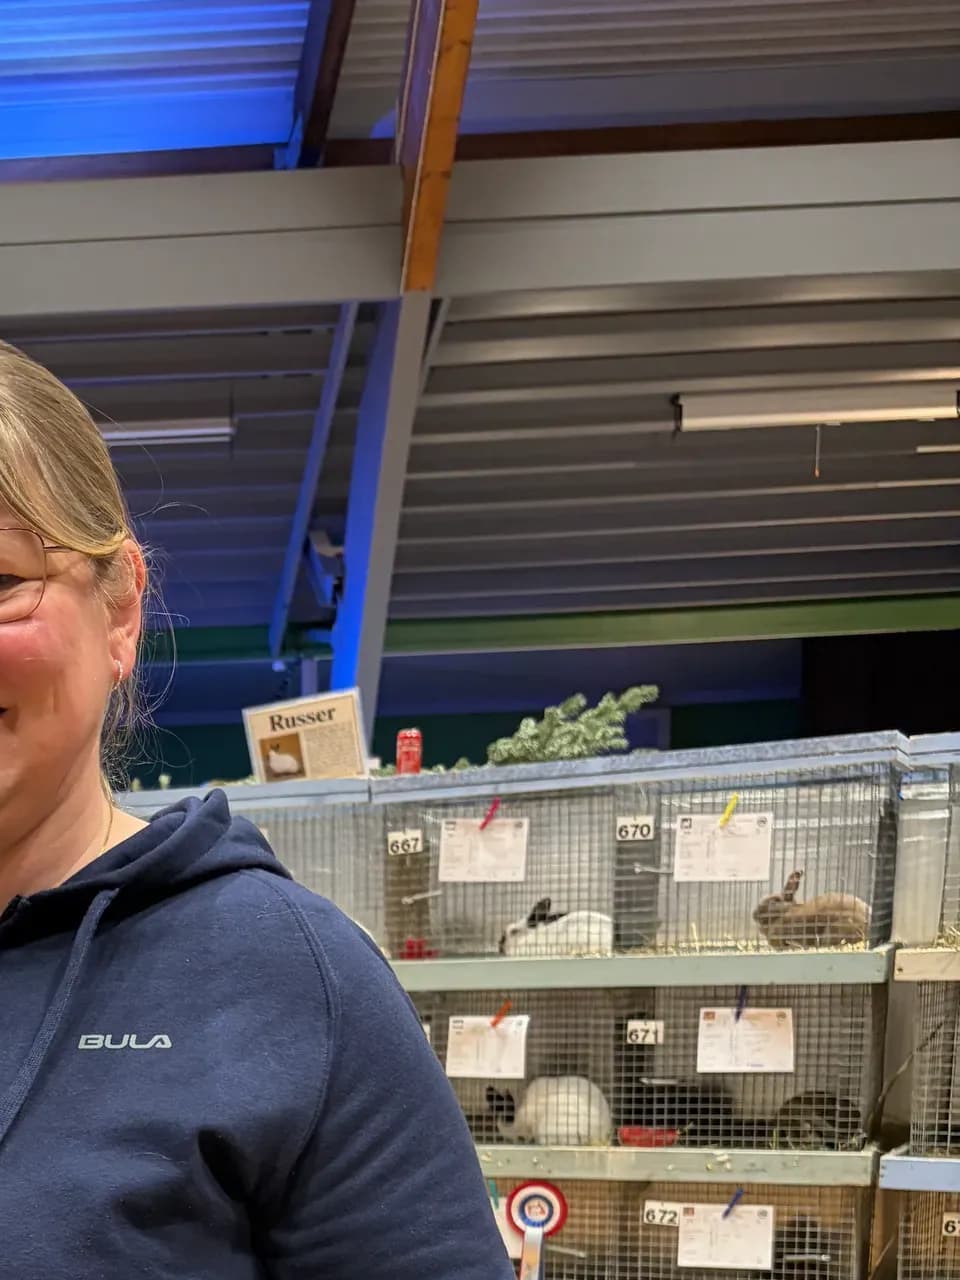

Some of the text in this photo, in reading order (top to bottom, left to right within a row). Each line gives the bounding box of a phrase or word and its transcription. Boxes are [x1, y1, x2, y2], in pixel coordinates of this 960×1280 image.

[269, 707, 337, 732] Russer
[618, 823, 651, 838] 670
[390, 837, 420, 854] 667
[78, 1034, 172, 1049] BULA
[628, 1028, 660, 1043] 671
[646, 1208, 678, 1225] 672
